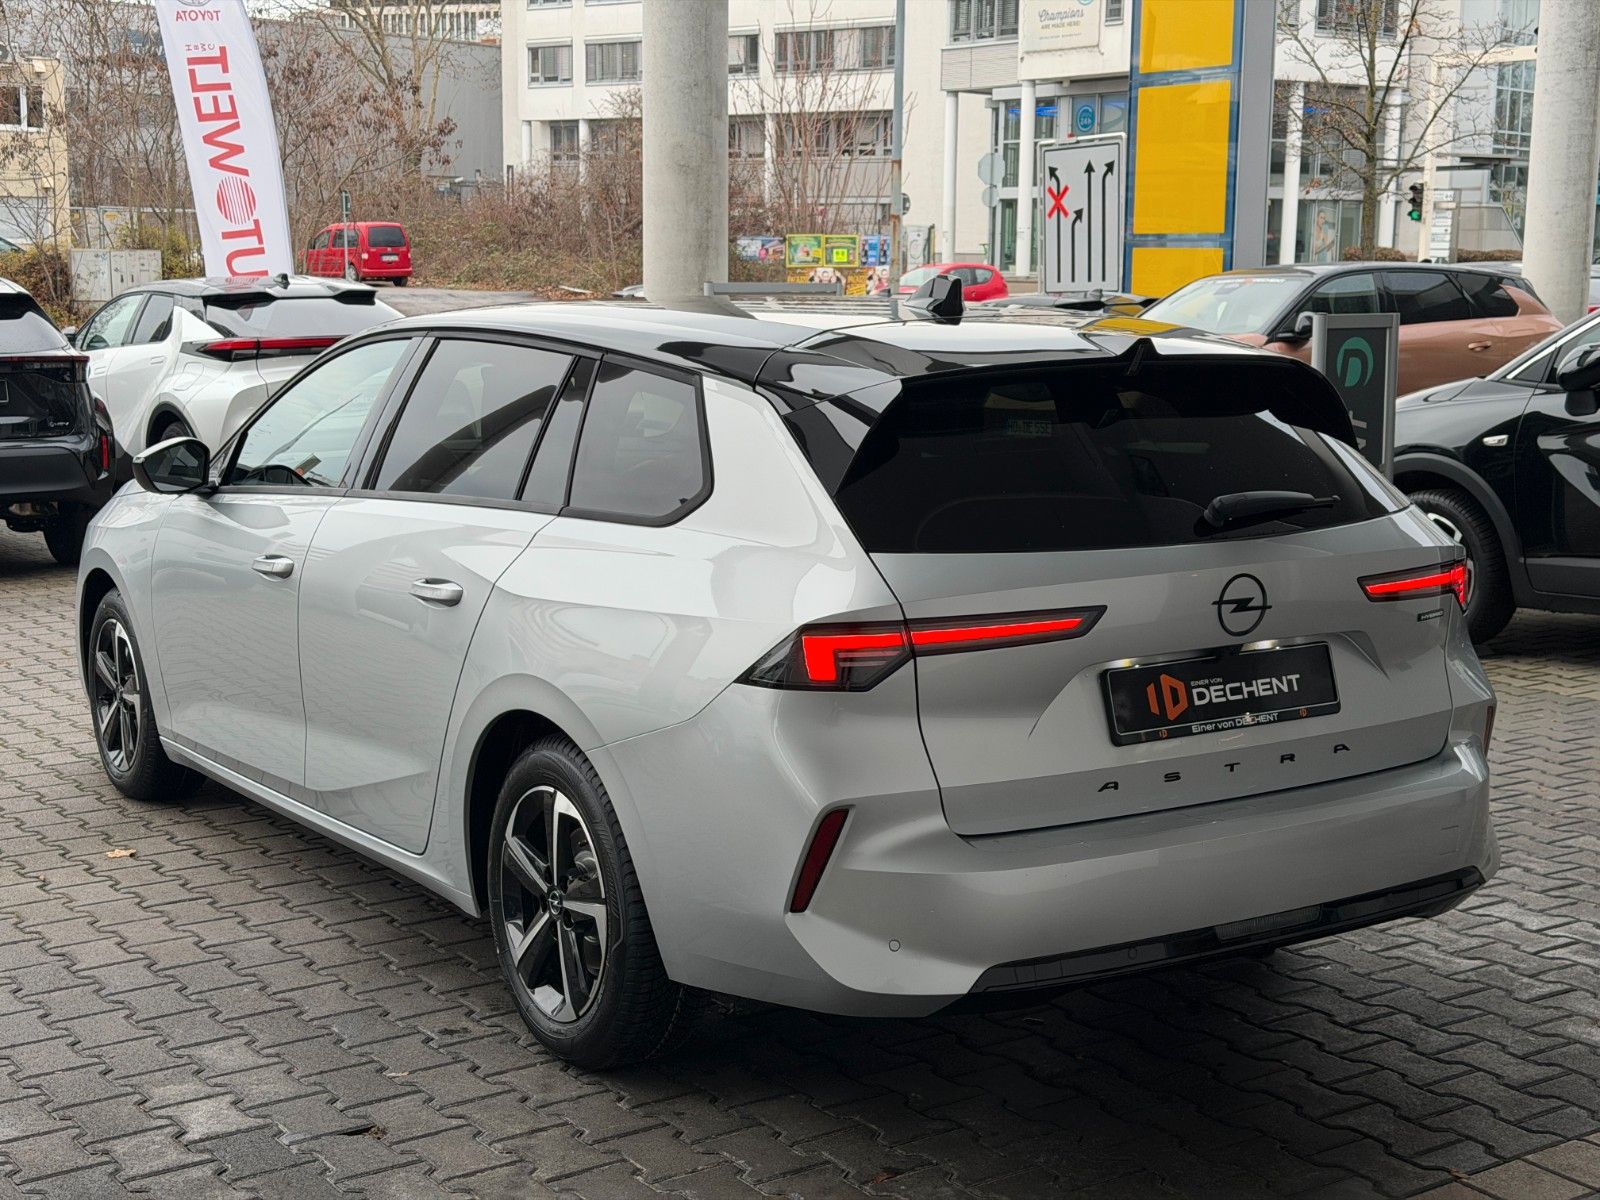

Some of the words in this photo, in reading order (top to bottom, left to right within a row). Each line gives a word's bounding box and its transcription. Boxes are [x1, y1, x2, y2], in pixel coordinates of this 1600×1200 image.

[1038, 8, 1084, 22] Champions
[1191, 678, 1208, 687] EINER
[1209, 677, 1223, 685] VON
[1192, 674, 1300, 706] DECHENT
[1192, 723, 1216, 733] Einer
[1217, 720, 1235, 730] von
[1236, 713, 1279, 726] DECHENT
[1098, 743, 1351, 792] ASTRA
